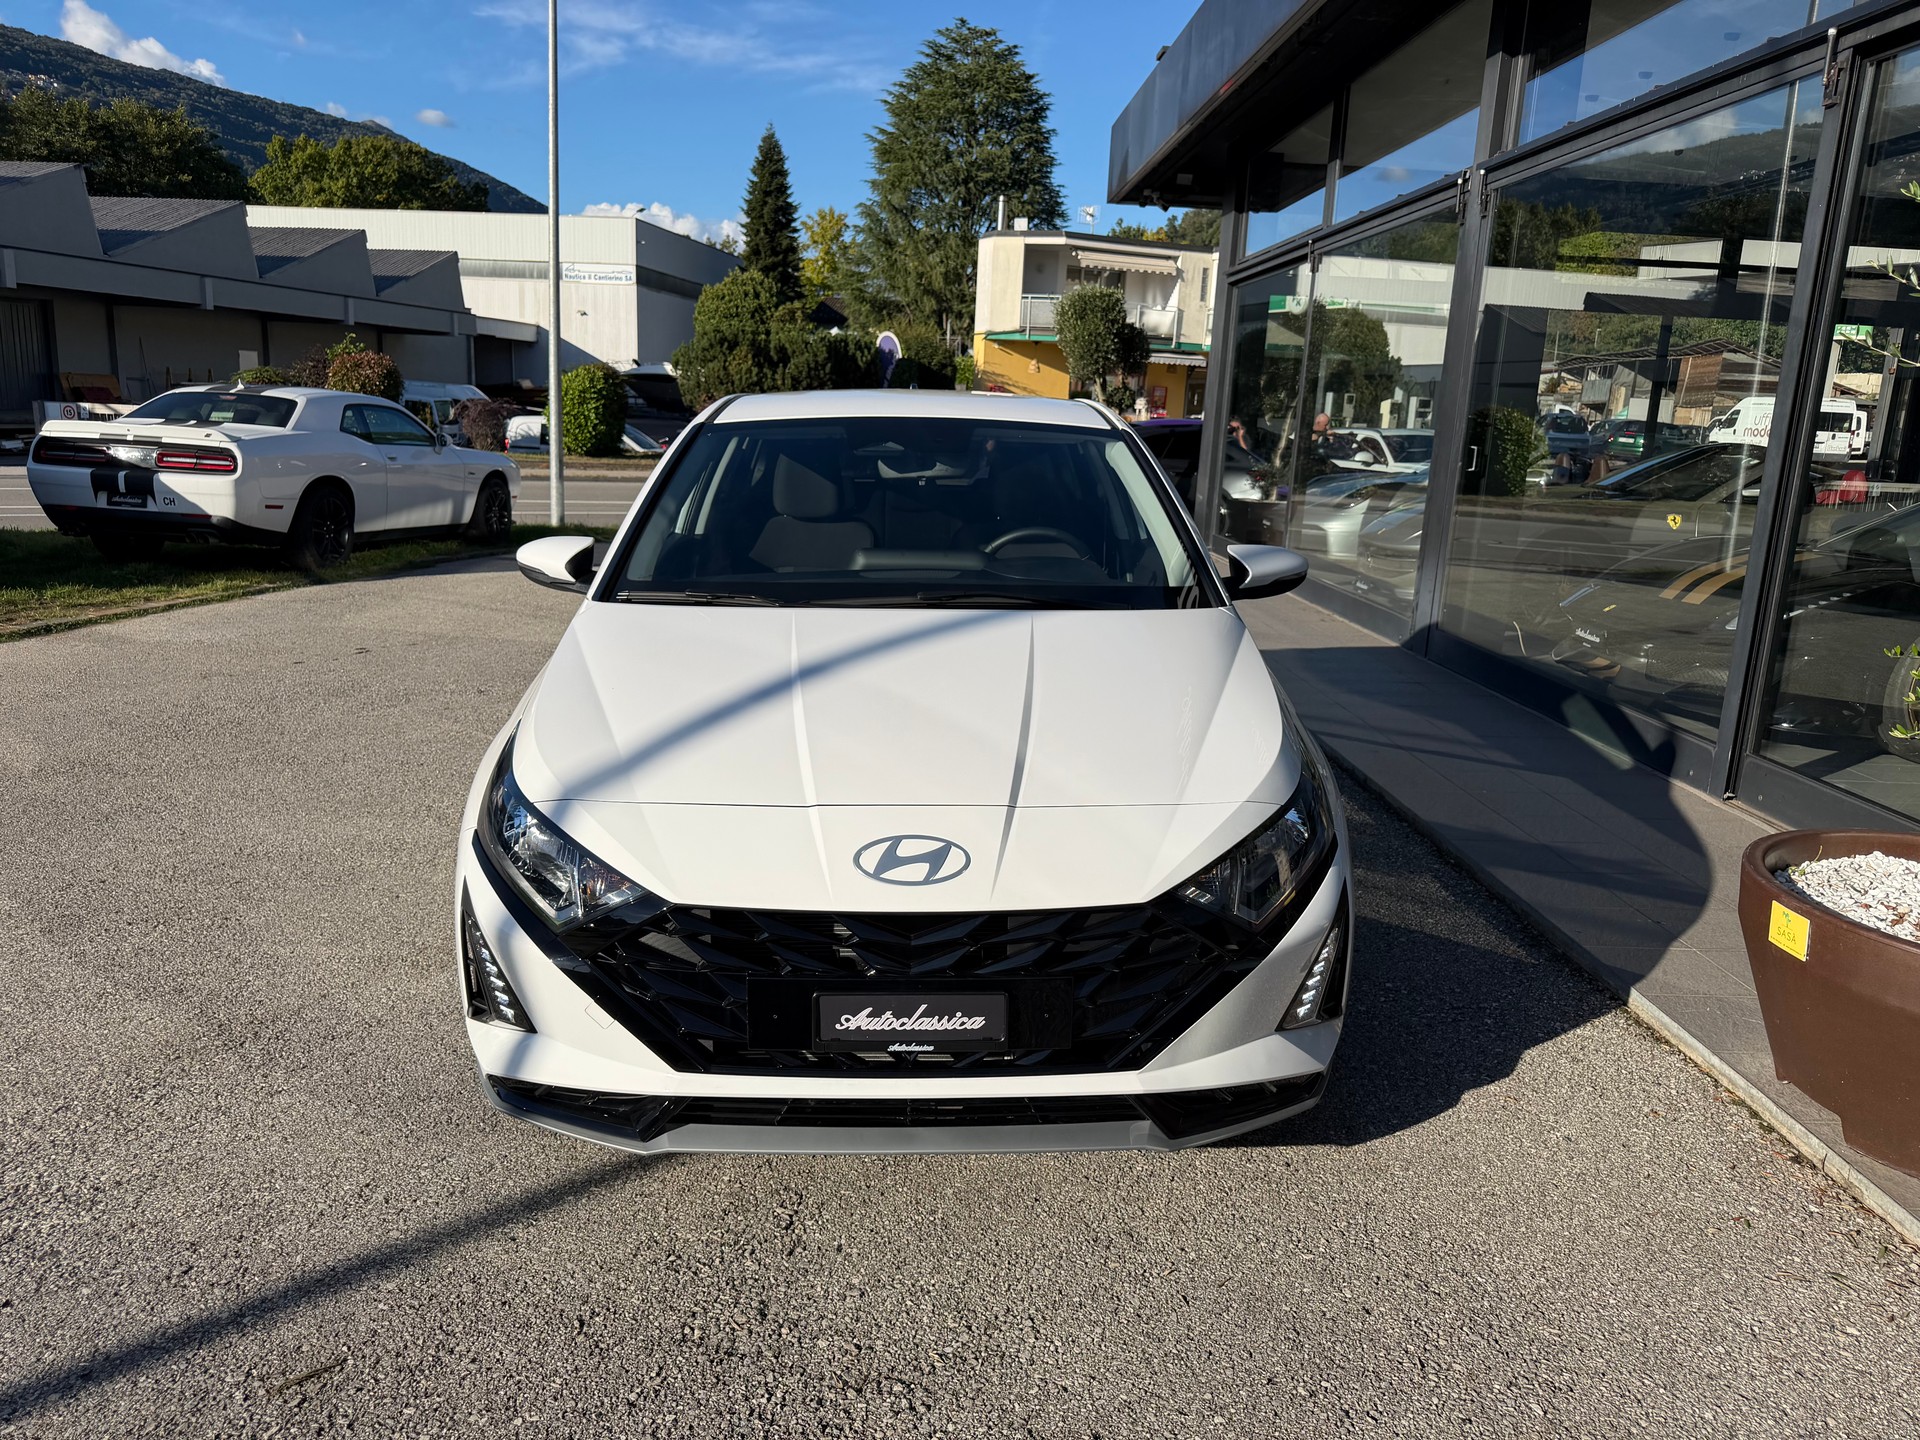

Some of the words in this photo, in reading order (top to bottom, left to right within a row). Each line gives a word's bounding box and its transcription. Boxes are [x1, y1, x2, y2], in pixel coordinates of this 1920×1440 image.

[163, 497, 176, 506] CH
[835, 1004, 986, 1030] Autoclassica
[888, 1043, 934, 1051] Autoclassica
